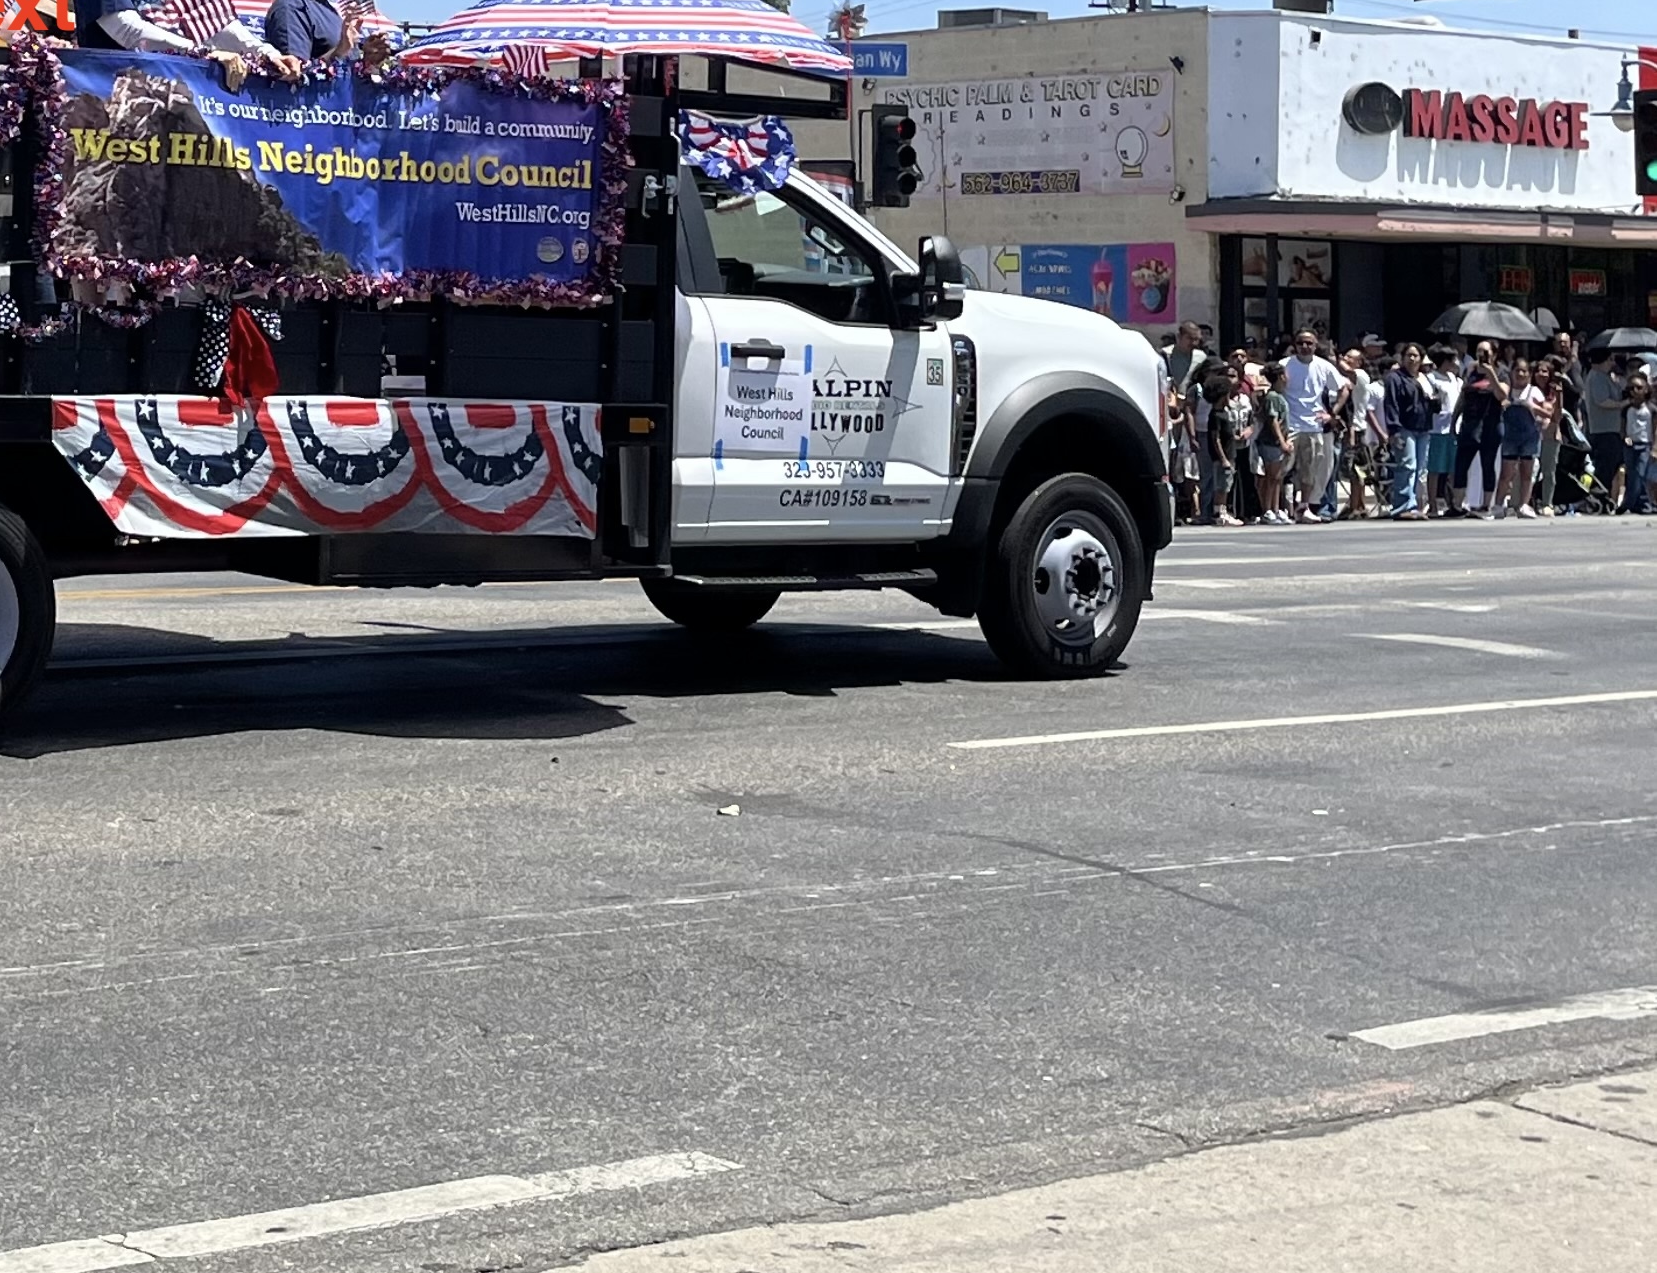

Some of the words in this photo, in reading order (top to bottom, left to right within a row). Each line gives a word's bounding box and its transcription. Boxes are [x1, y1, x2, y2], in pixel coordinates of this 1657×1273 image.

[852, 53, 874, 68] an
[879, 49, 902, 73] Wy
[885, 87, 960, 110] PSYCHIC
[965, 82, 1014, 107] PALM
[1019, 80, 1034, 104] &
[1041, 78, 1101, 103] TAROT
[1106, 75, 1163, 100] CARD
[198, 95, 226, 117] It's
[228, 102, 259, 120] our
[398, 112, 440, 132] Let's
[444, 115, 481, 135] build
[484, 123, 496, 136] a
[497, 122, 596, 144] community.
[923, 102, 1121, 125] READINGS
[1403, 88, 1590, 151] MASSAGE
[70, 128, 161, 165] West
[166, 131, 253, 171] Hills
[257, 141, 472, 187] Neighborhood
[474, 154, 594, 191] Council
[962, 171, 1079, 194] 562-964-3737
[455, 201, 591, 230] WestHillsNC.org
[928, 365, 943, 383] 35
[737, 384, 766, 400] West
[768, 386, 794, 401] Hills
[724, 404, 803, 421] Neighborhood
[811, 410, 884, 433] LLYWOOD
[741, 425, 785, 441] Council
[779, 489, 868, 507] CA#109158
